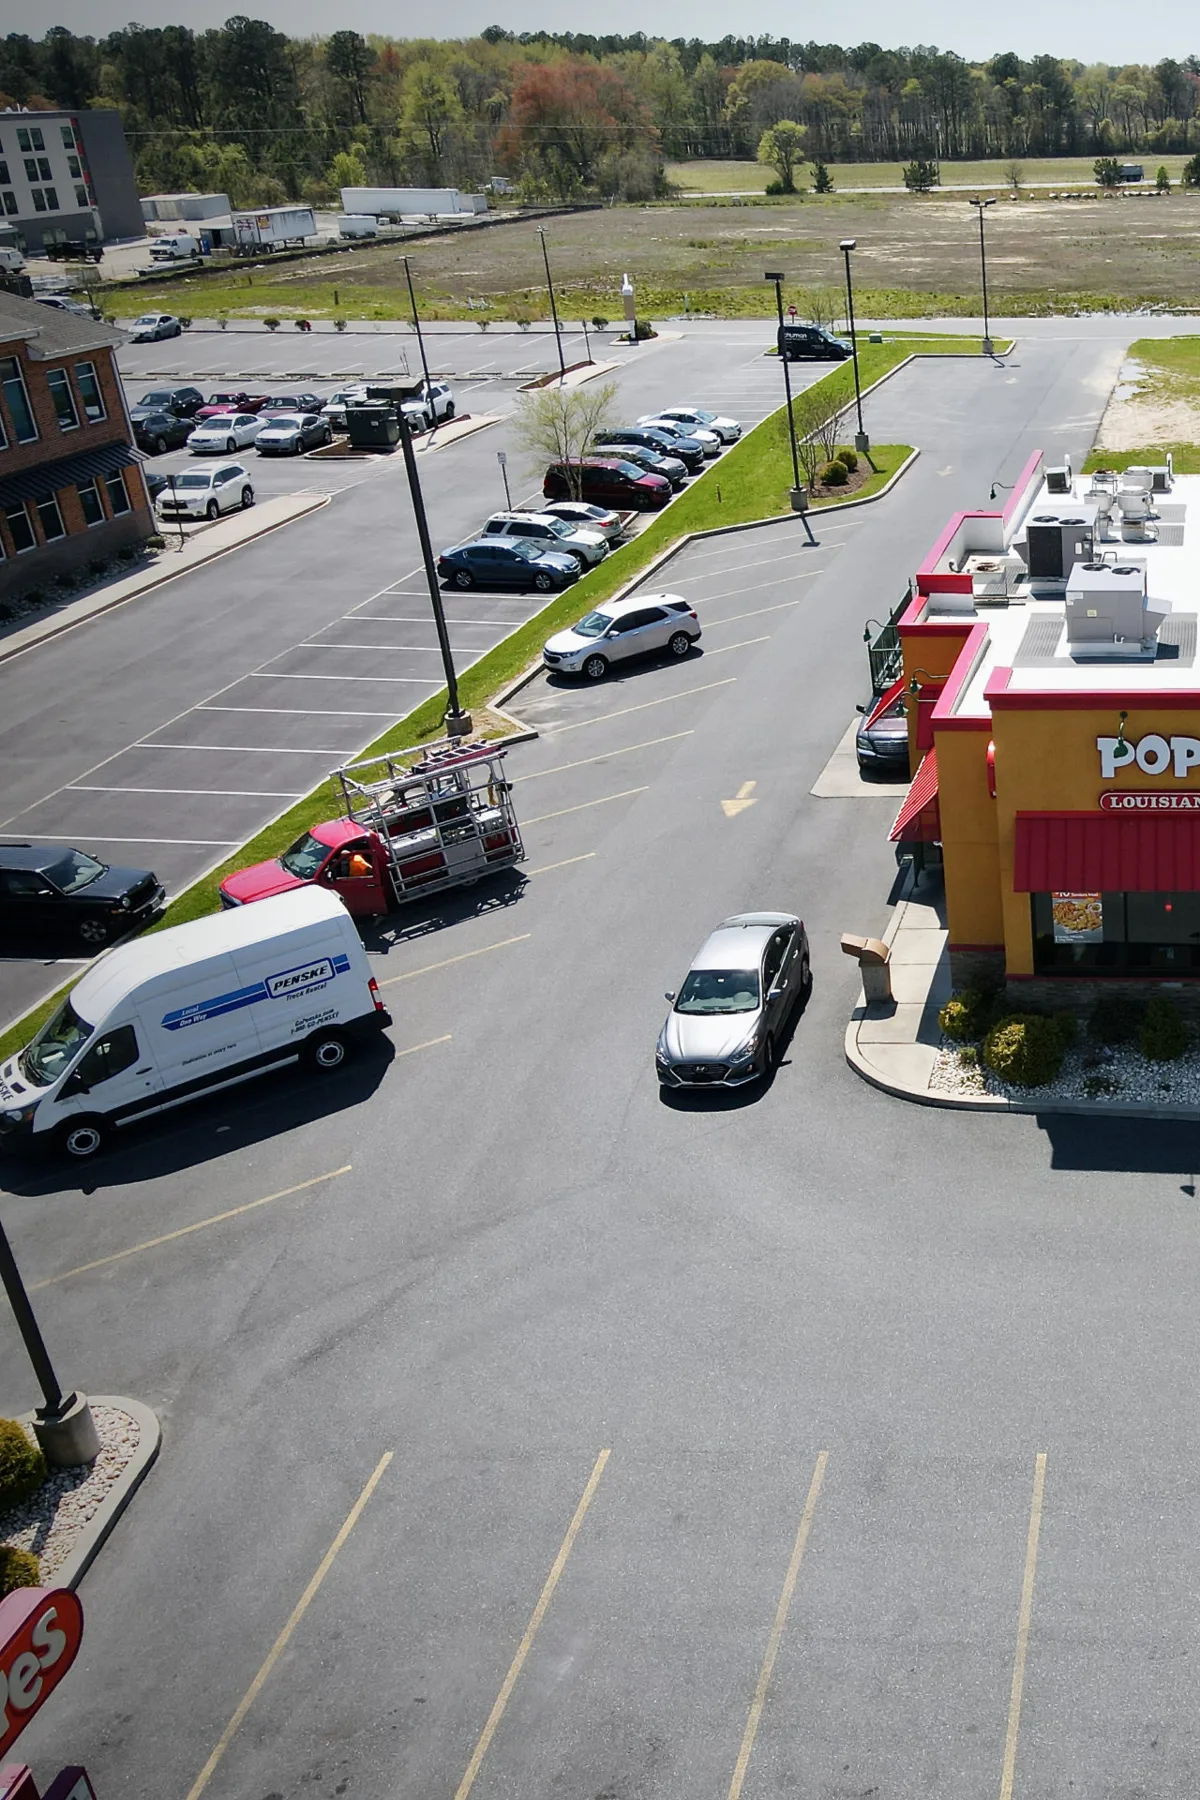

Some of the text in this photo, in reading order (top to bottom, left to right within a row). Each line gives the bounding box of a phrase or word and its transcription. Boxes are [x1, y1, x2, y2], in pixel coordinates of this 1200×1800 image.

[273, 965, 328, 992] PENSKE
[286, 982, 327, 1001] Truck Rental
[181, 1005, 199, 1016] Local
[180, 1014, 207, 1027] One Way
